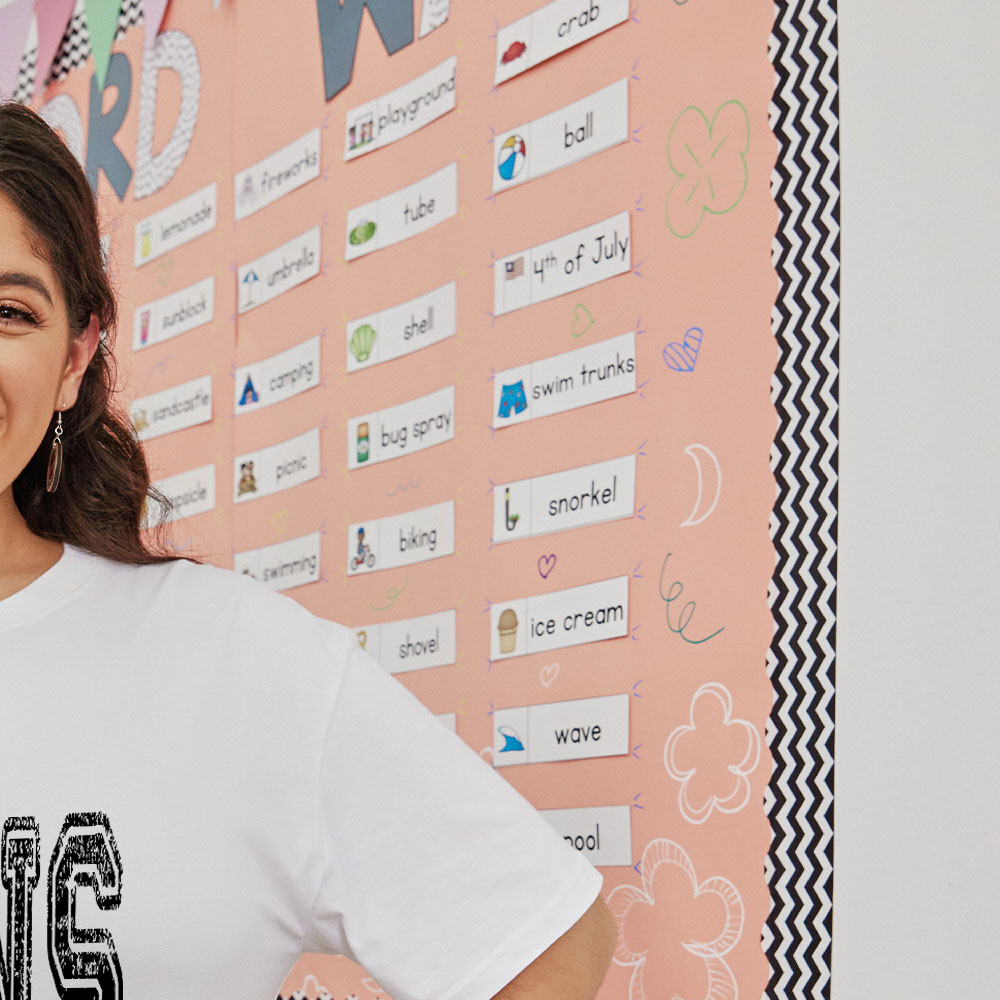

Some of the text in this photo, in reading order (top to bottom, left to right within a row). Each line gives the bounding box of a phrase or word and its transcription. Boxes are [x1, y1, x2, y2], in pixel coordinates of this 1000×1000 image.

[557, 0, 601, 38] crab
[377, 66, 457, 136] playground
[564, 111, 594, 149] ball
[259, 147, 319, 193] fireworks
[159, 200, 214, 243] lemonade
[403, 196, 437, 224] tube
[265, 247, 315, 288] umbrella
[534, 231, 630, 284] 4th of July
[161, 292, 209, 330] sunblock
[403, 307, 436, 341] shell
[268, 360, 315, 393] camping
[532, 352, 635, 400] swim trunks
[380, 410, 453, 449] bug spray
[275, 454, 308, 484] picnic
[548, 475, 618, 517] snorkel
[400, 528, 438, 552] biking
[263, 552, 317, 583] swimming
[530, 603, 624, 638] ice cream
[399, 627, 440, 660] shovel
[555, 725, 602, 745] wave
